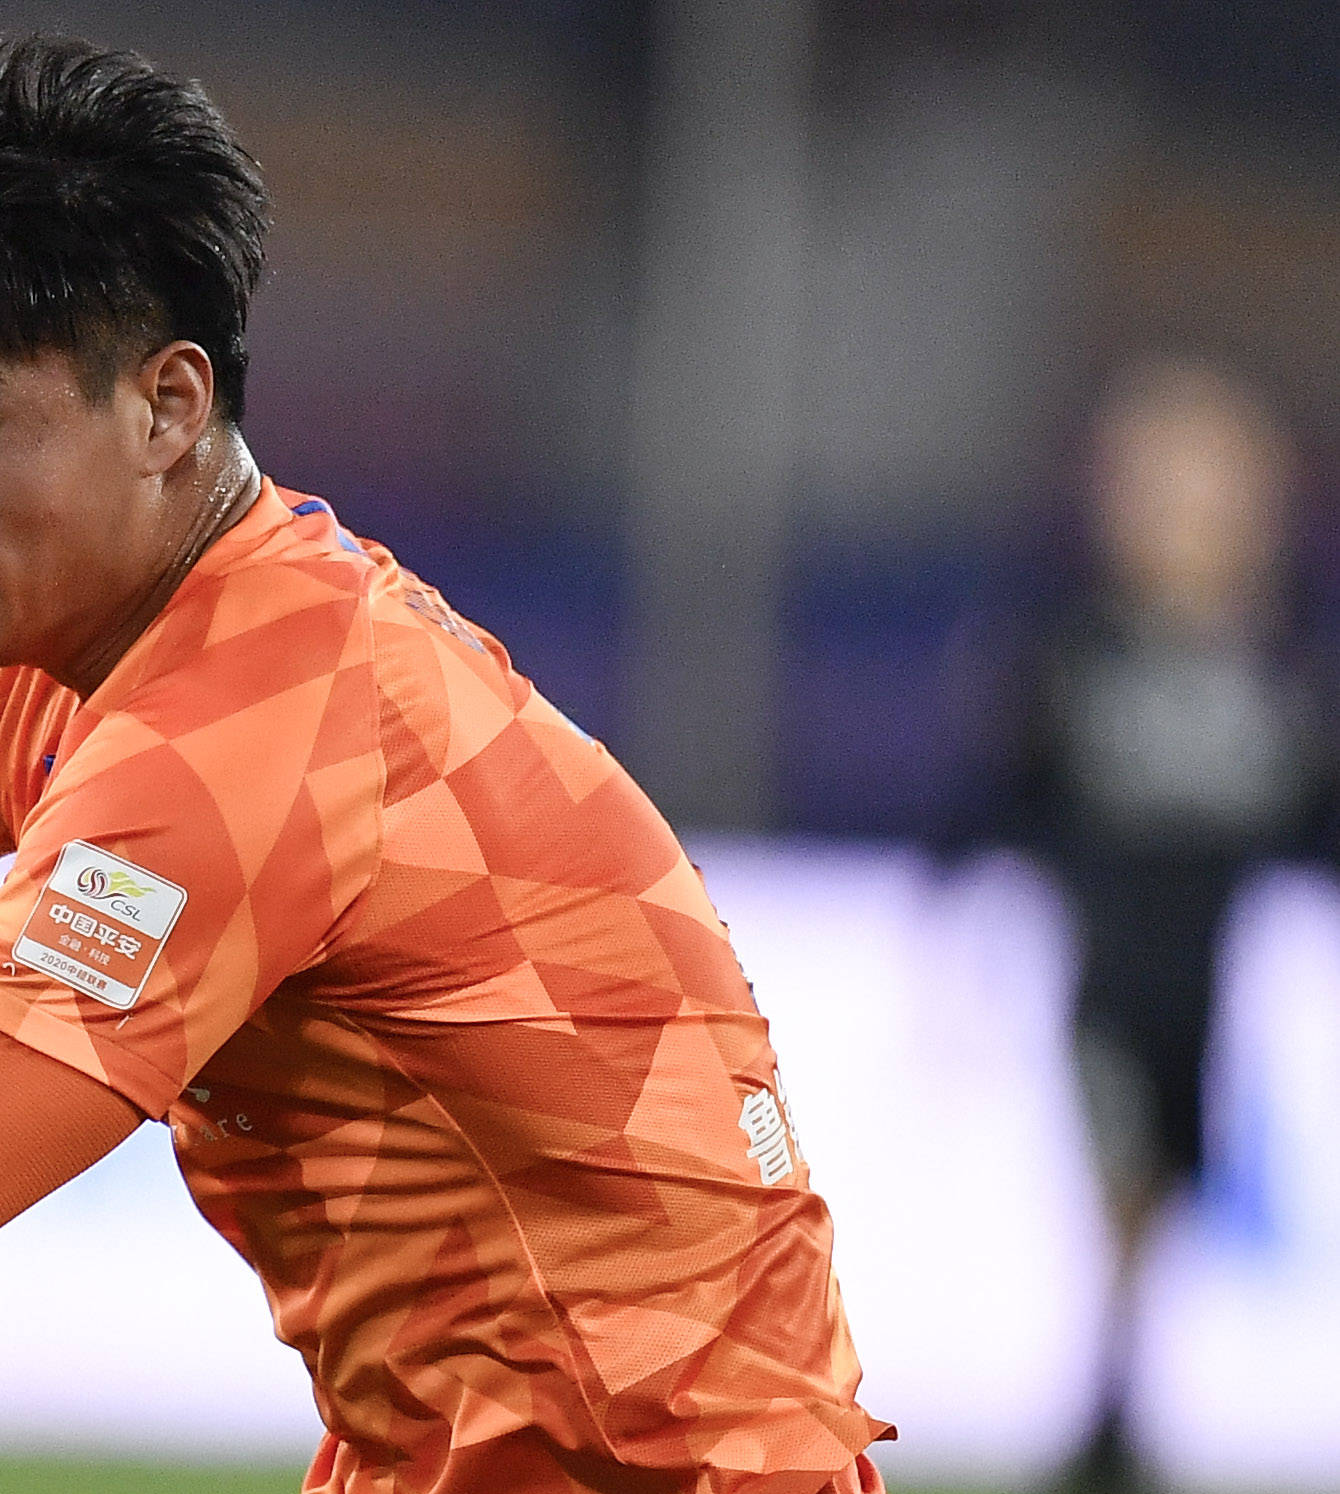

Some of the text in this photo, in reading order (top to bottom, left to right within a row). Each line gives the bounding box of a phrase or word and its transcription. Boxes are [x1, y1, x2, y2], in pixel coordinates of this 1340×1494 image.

[110, 899, 142, 922] CSL
[49, 902, 142, 960] 中国平安
